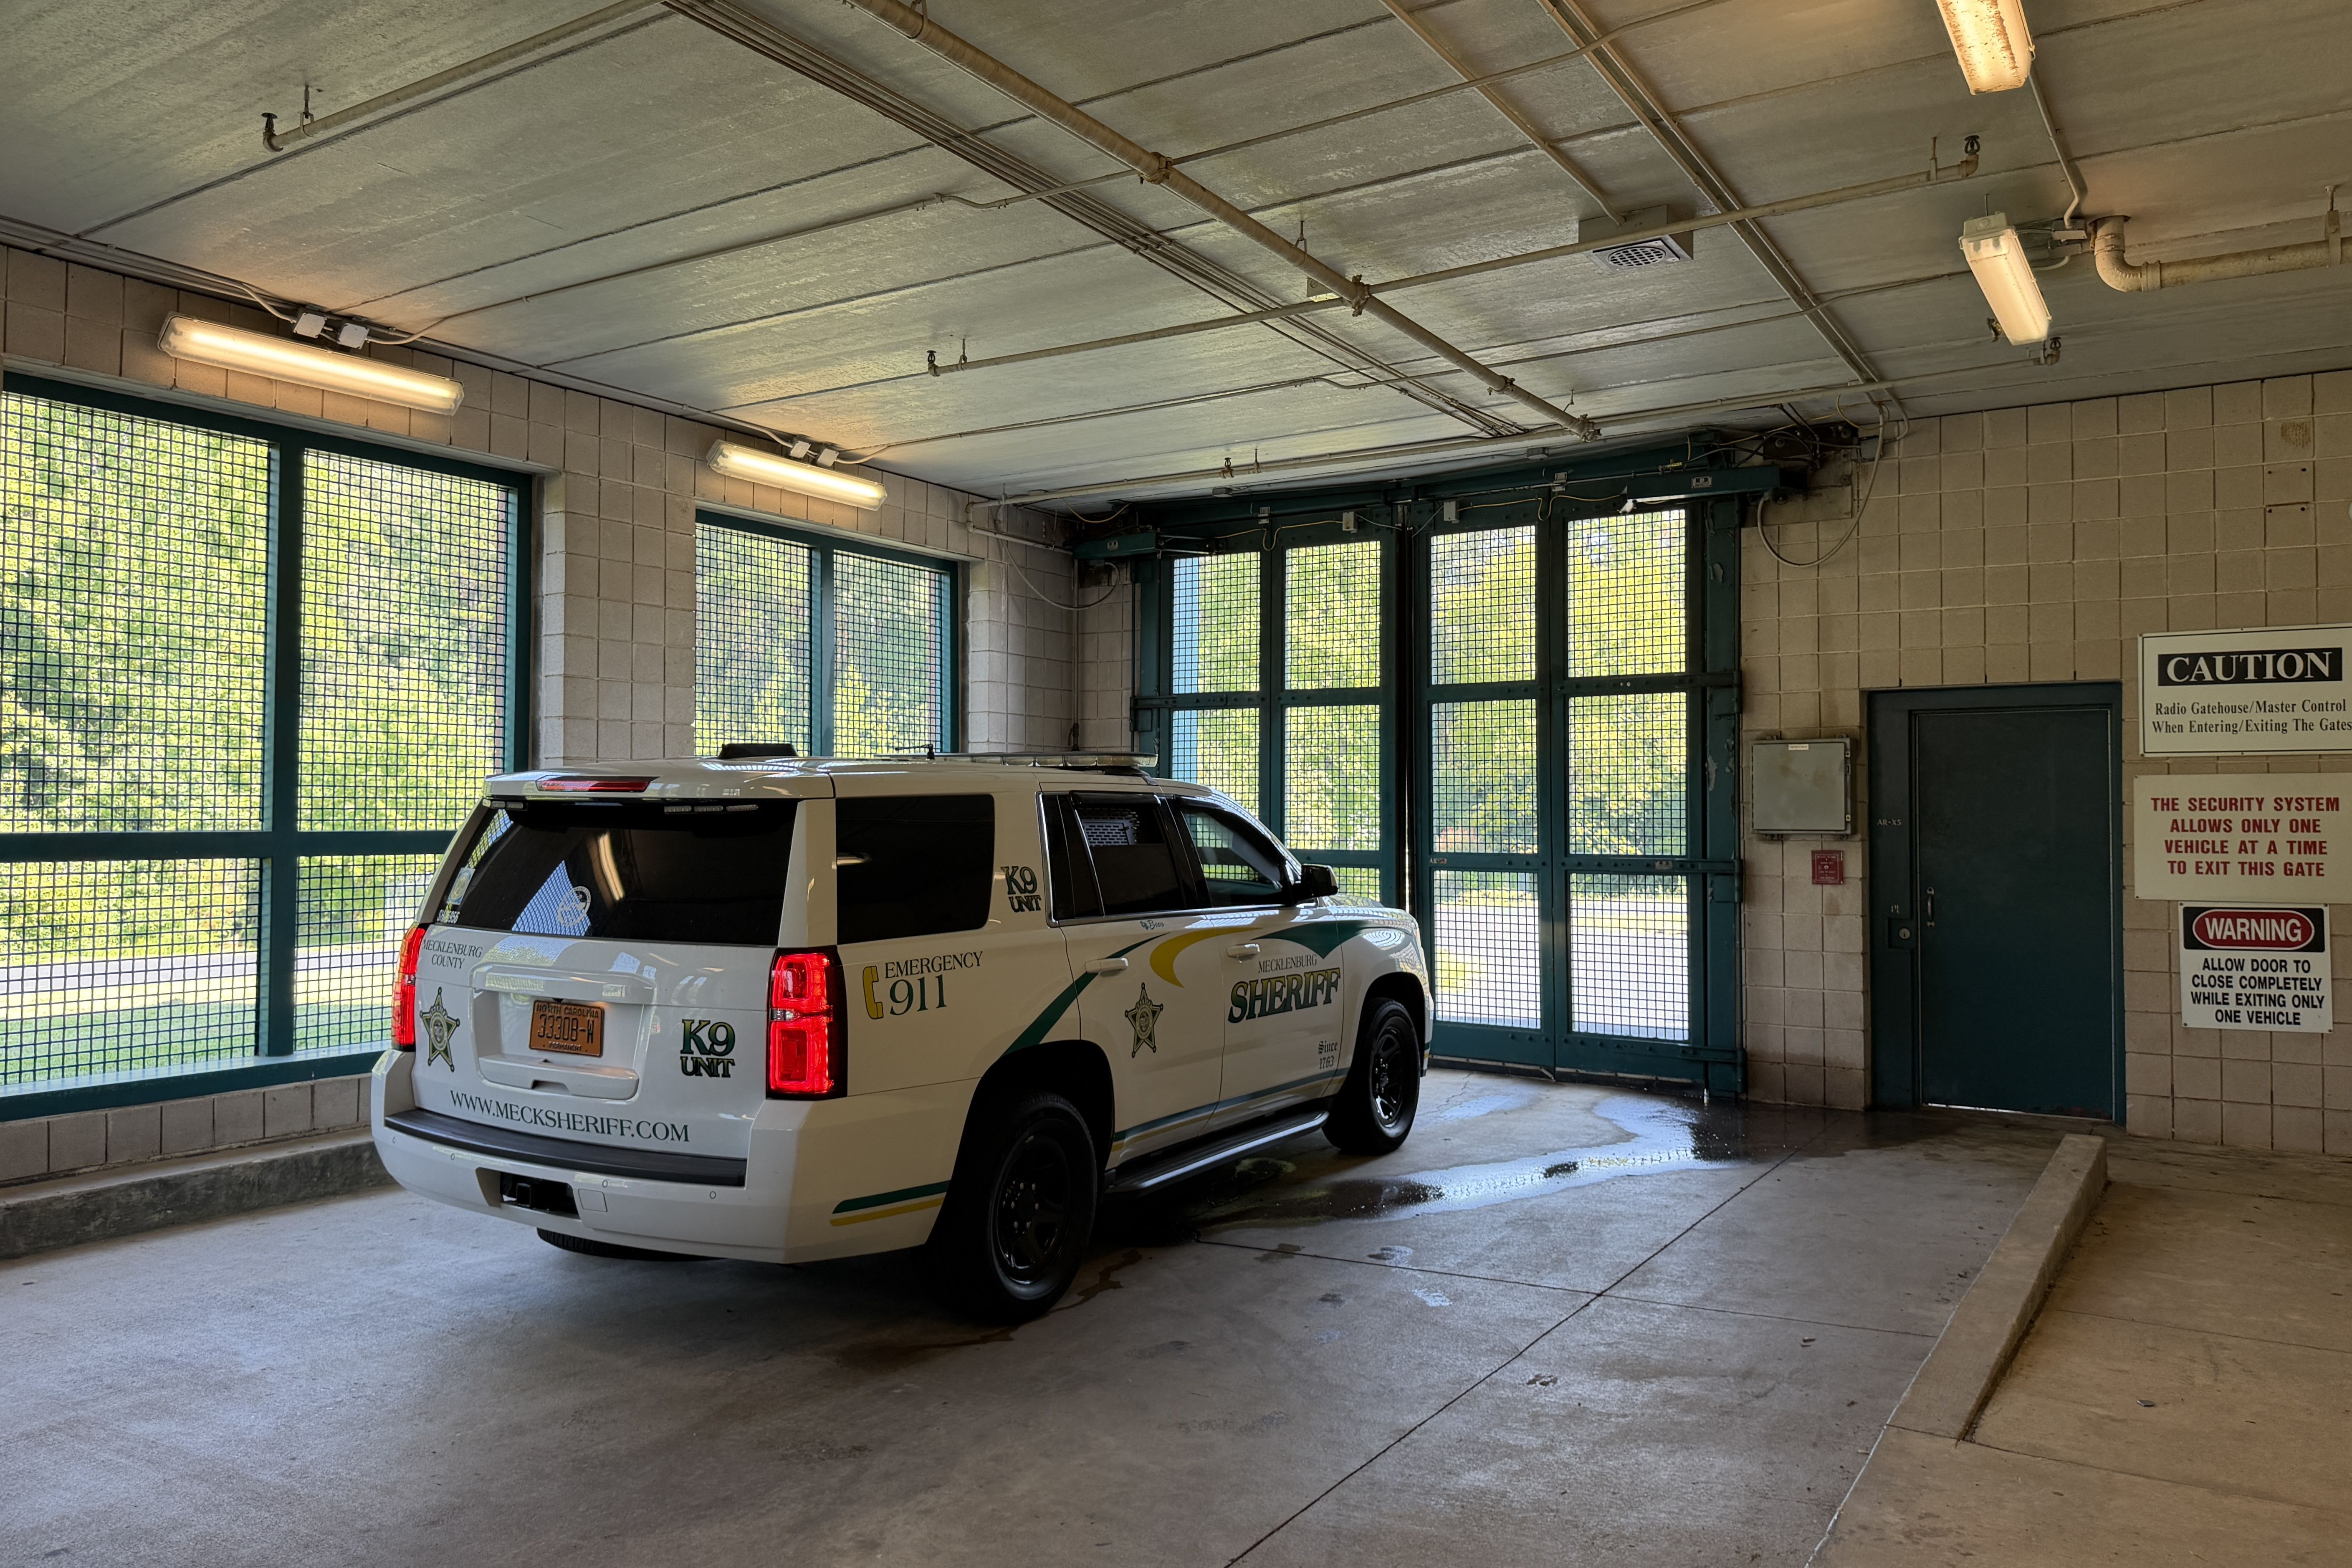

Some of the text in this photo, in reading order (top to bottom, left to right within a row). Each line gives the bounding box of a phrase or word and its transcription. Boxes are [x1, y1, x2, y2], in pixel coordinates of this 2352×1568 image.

[2167, 652, 2332, 682] CAUTION
[2156, 699, 2346, 715] Radio Gatehouse/Master Control
[2152, 718, 2352, 735] When Entering/Exiting The Gates
[2150, 797, 2339, 812] THE SECURITY SYSTEM
[2170, 819, 2321, 833] ALLOWS ONLY ONE
[2164, 840, 2327, 855] VEHICLE AT A TIME
[2167, 860, 2325, 877] TO EXIT THIS GATE
[1001, 865, 1037, 895] K9
[1009, 895, 1042, 913] UNIT
[2205, 918, 2302, 942] WARNING
[422, 939, 483, 958] MECKLENBURG
[431, 954, 465, 969] COUNTY
[885, 951, 984, 979] EMERGENCY
[1258, 954, 1317, 974] MECKLENBURG
[2202, 958, 2311, 974] ALLOW DOOR TO
[2192, 974, 2322, 991] CLOSE COMPLETELY
[890, 974, 947, 1016] 911
[1228, 967, 1340, 1023] SHERIFF
[2190, 991, 2324, 1009] WHILE EXITING ONLY
[536, 1004, 599, 1018] NORTH CAROLINA
[2215, 1009, 2301, 1026] ONE VEHICLE
[680, 1019, 736, 1056] K9
[1318, 1041, 1338, 1055] Since
[680, 1056, 735, 1078] UNIT
[1320, 1056, 1335, 1070] 1763
[450, 1090, 689, 1143] WWW.MECKSHERIFF.COM
